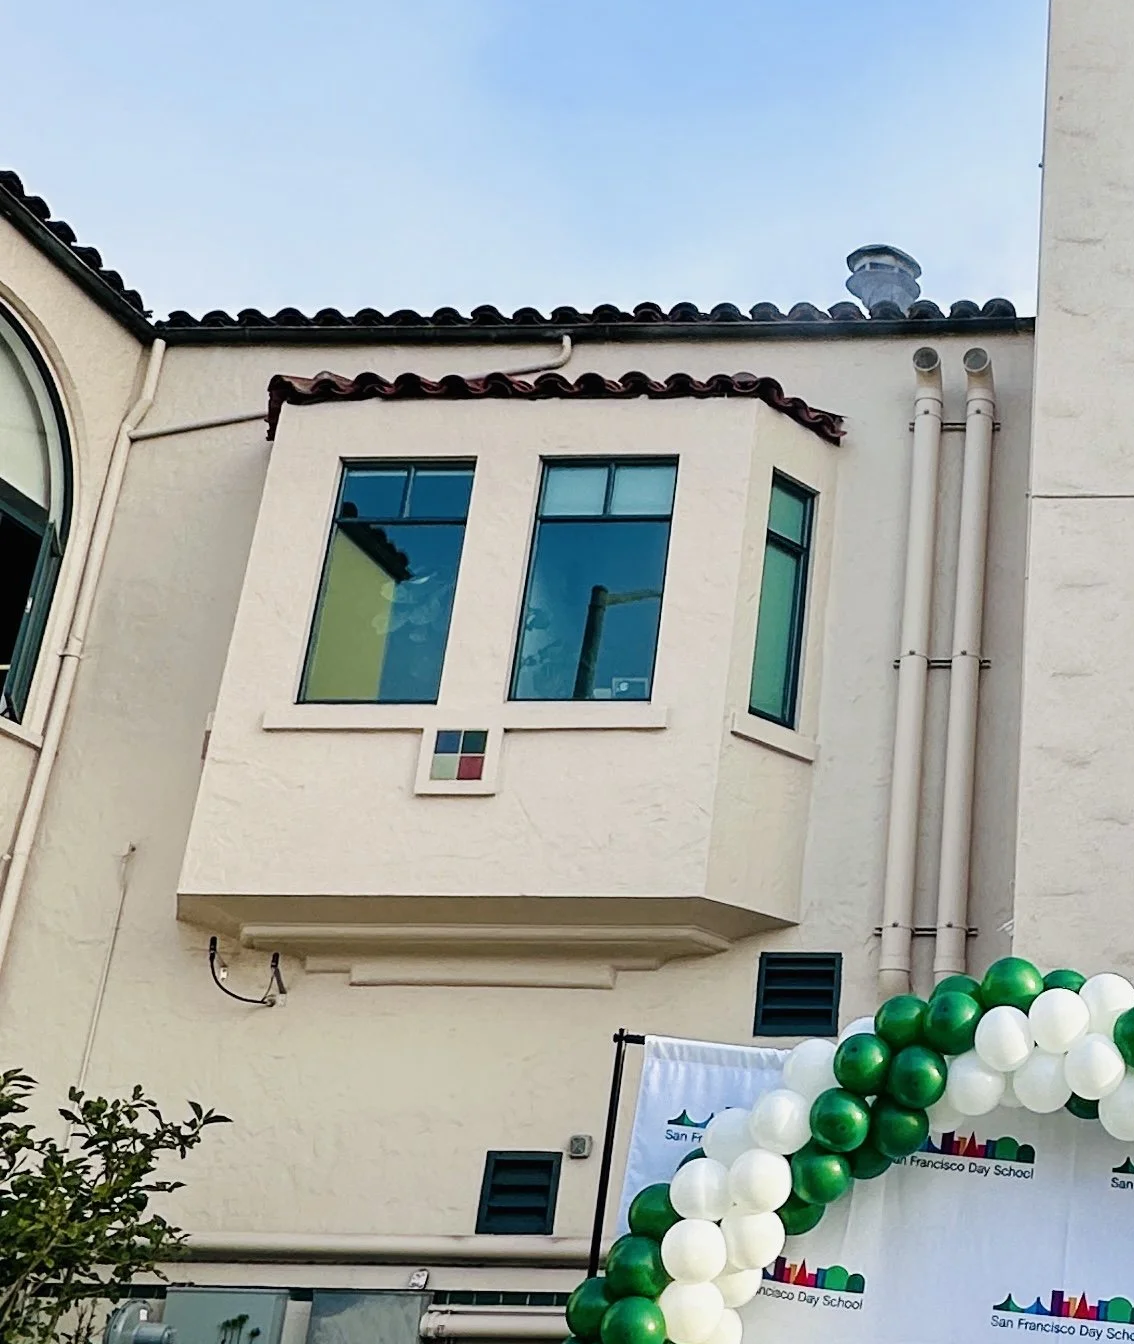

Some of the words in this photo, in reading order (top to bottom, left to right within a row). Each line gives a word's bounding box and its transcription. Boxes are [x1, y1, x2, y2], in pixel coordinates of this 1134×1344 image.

[665, 1129, 687, 1141] San
[910, 1156, 965, 1172] Francisco
[968, 1162, 991, 1177] Day
[993, 1164, 1034, 1179] School
[1111, 1177, 1133, 1189] San
[756, 1286, 795, 1301] ncisco
[797, 1291, 820, 1307] Day
[822, 1294, 863, 1310] School
[990, 1315, 1014, 1328] San
[1017, 1318, 1076, 1336] Francisco
[1079, 1324, 1103, 1341] Day
